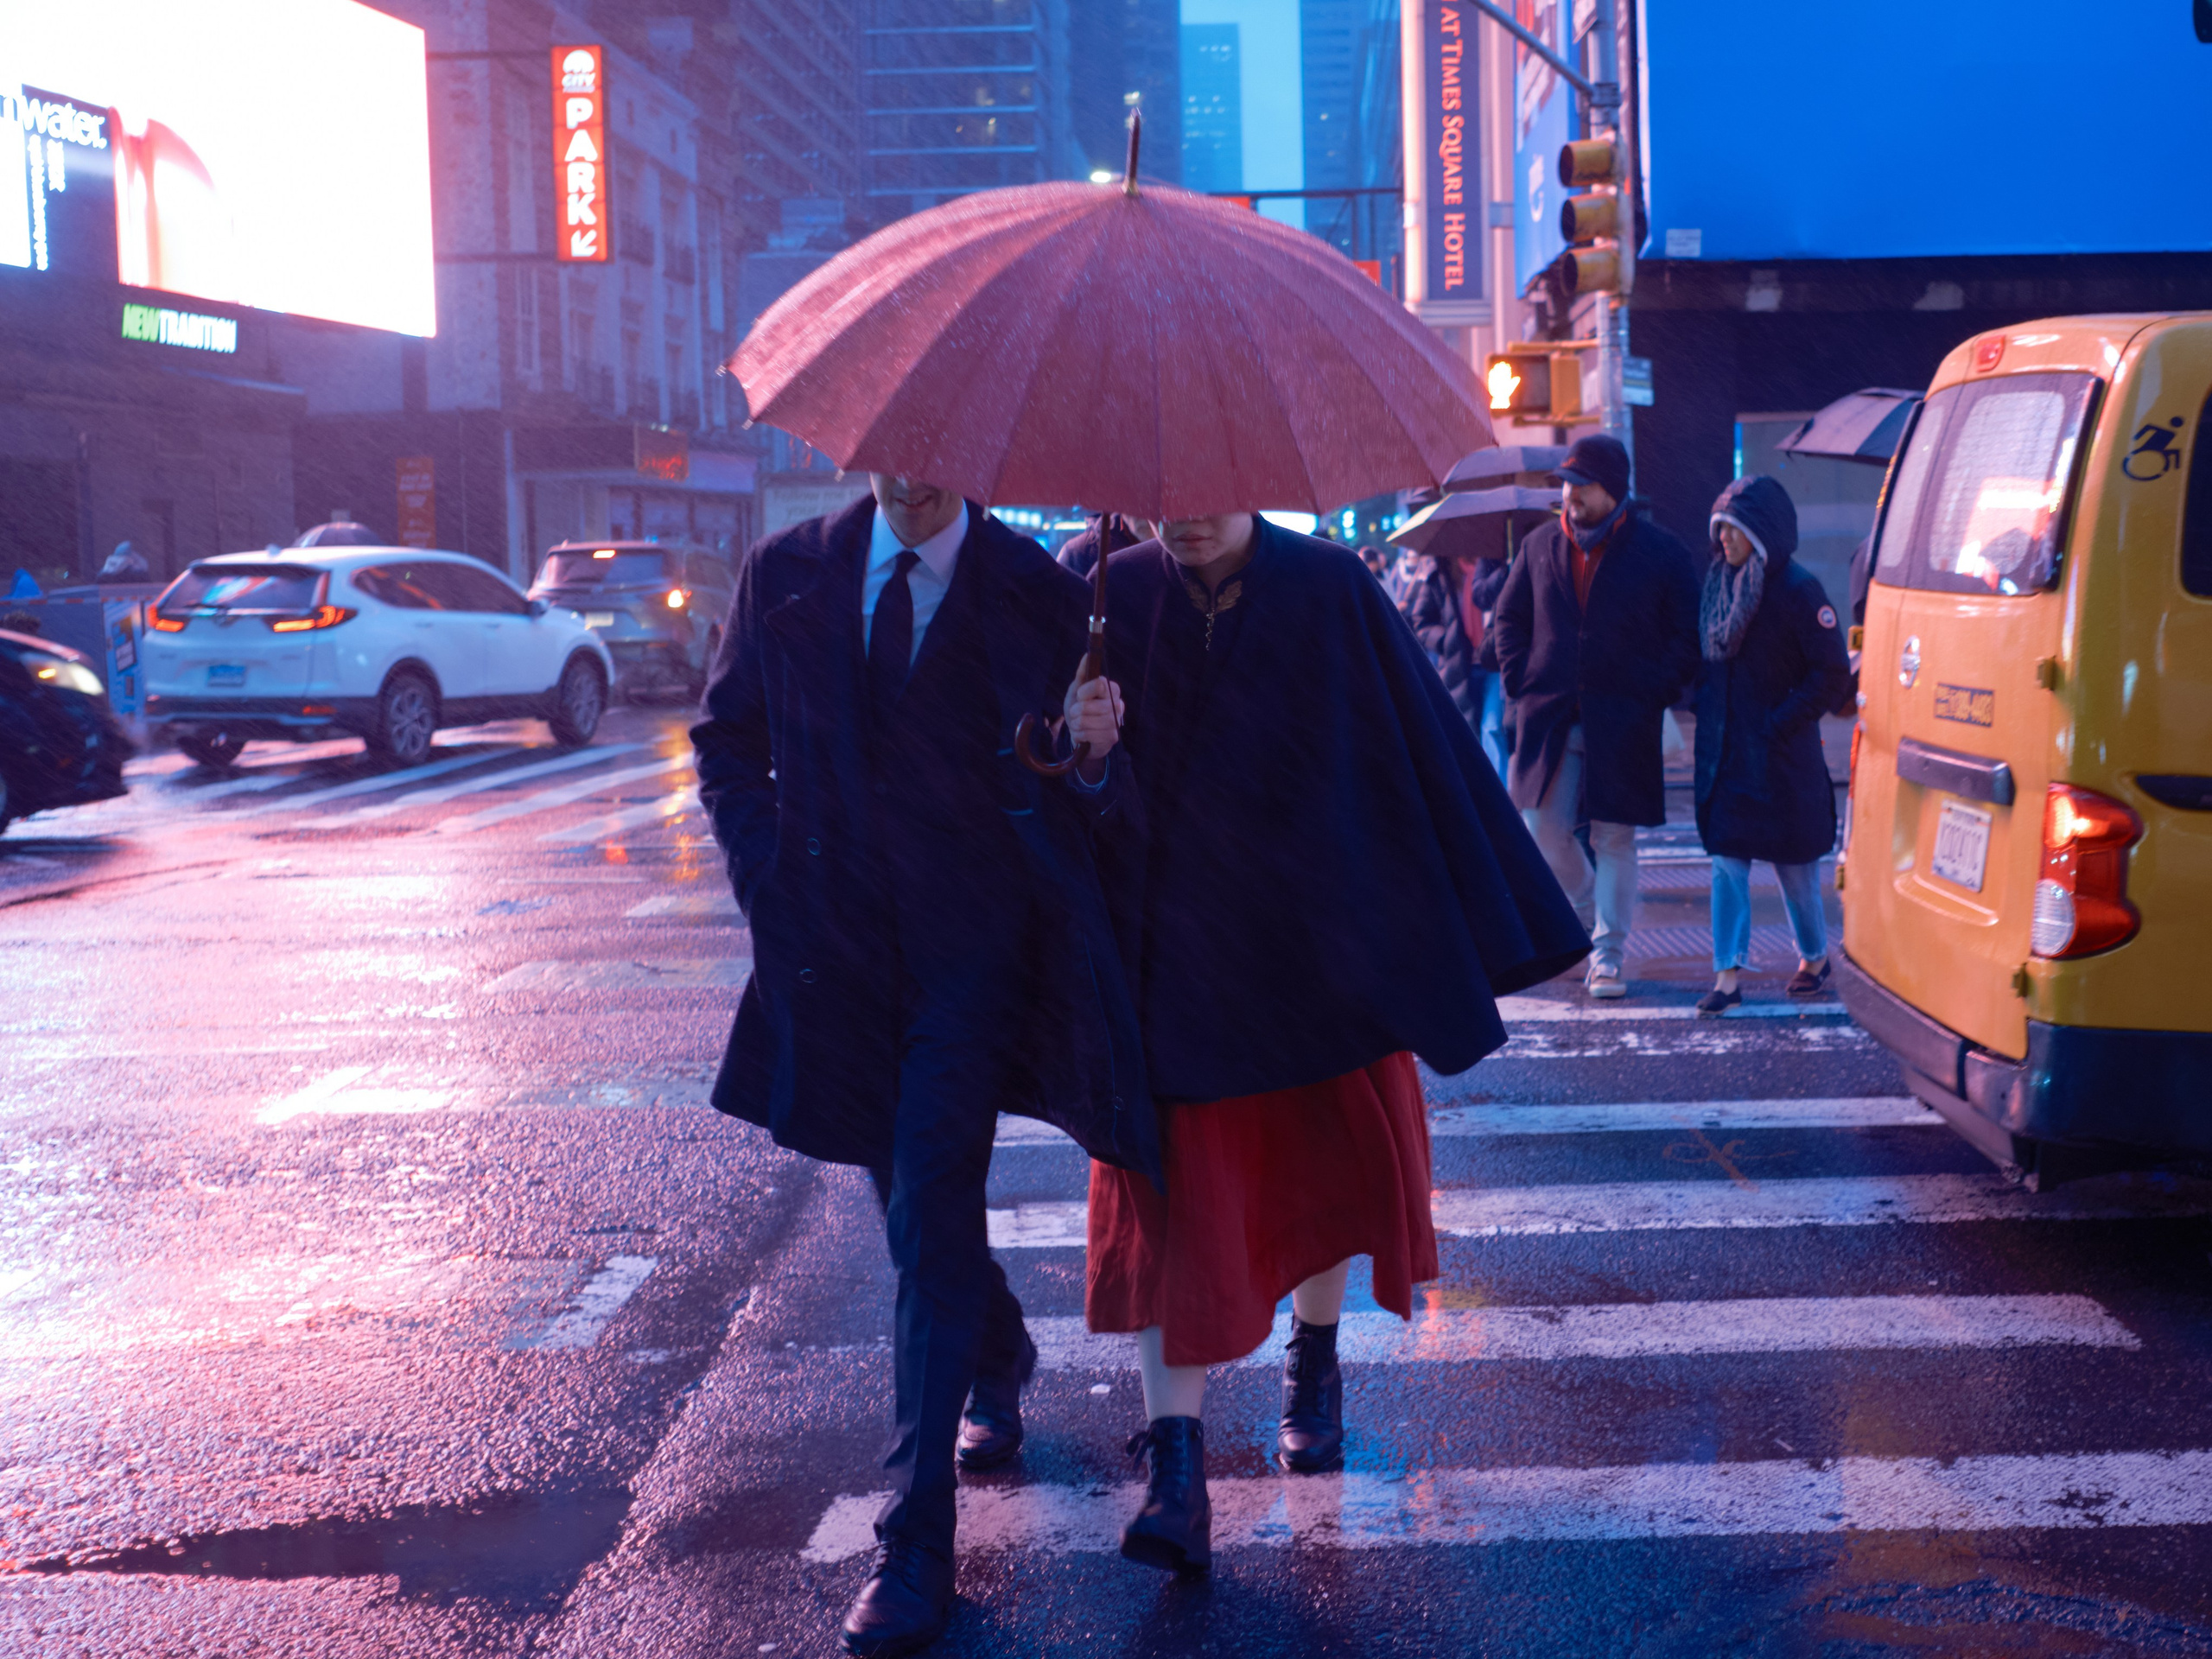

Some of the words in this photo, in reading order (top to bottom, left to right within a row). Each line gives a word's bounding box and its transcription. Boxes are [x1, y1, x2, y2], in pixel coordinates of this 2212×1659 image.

[1440, 7, 1460, 37] AT
[1441, 39, 1463, 111] TIMES
[564, 97, 598, 226] PARK
[1439, 115, 1465, 205] SQUARE
[1444, 213, 1465, 291] HOTEL
